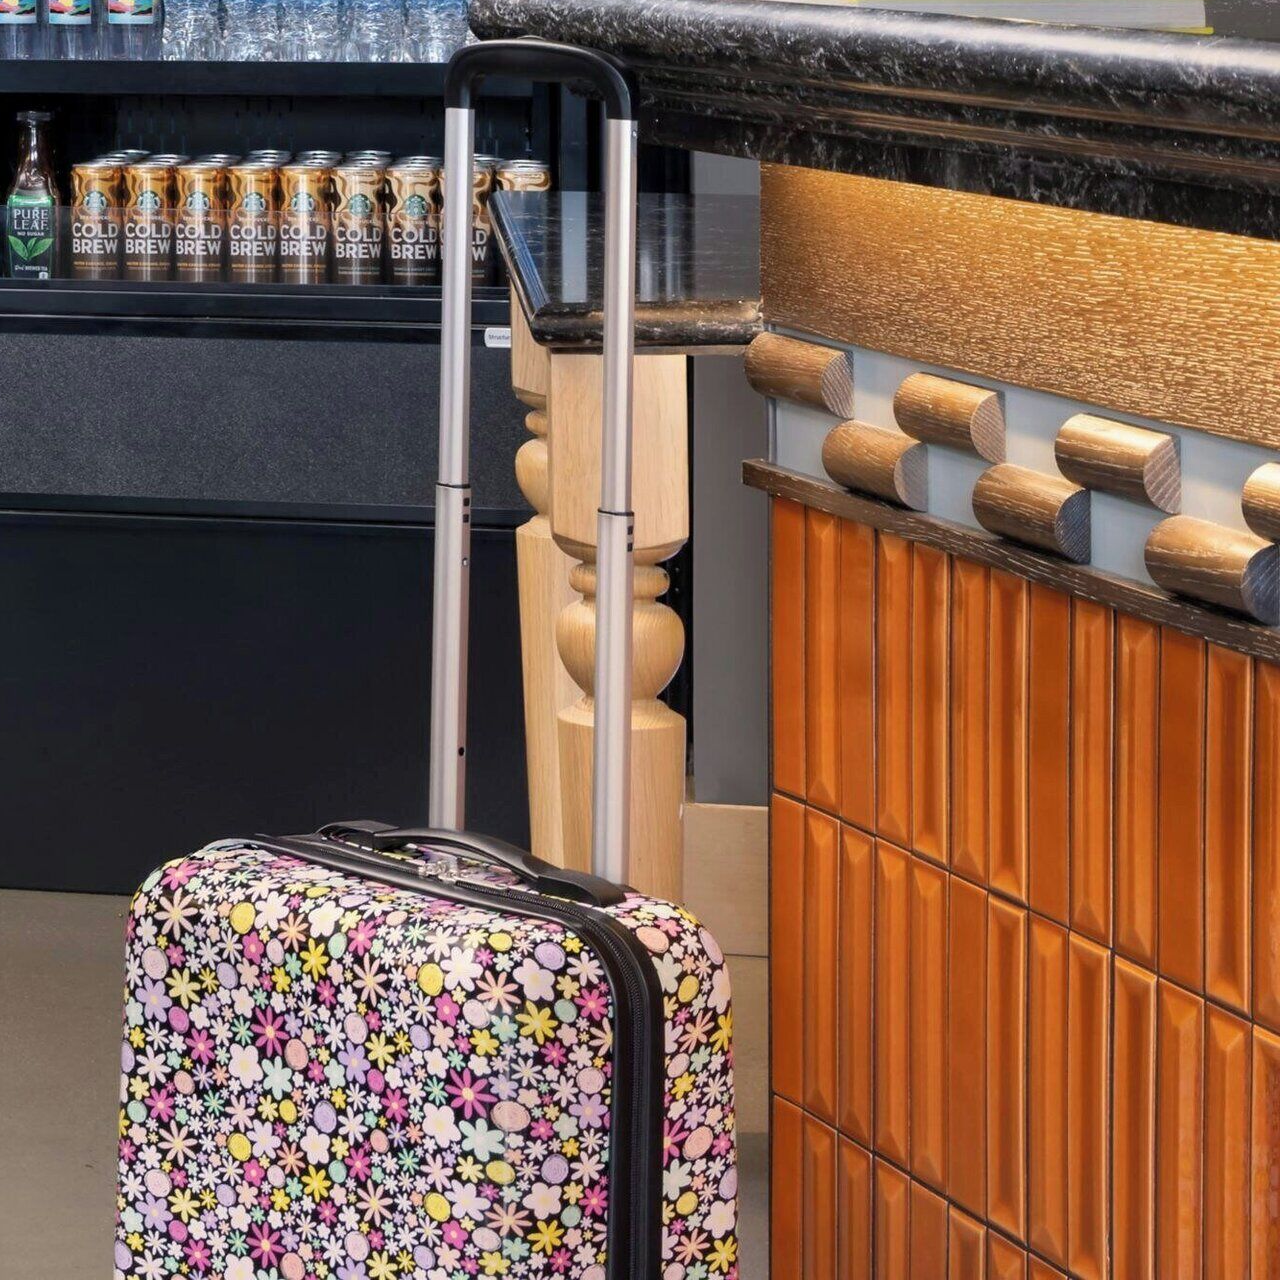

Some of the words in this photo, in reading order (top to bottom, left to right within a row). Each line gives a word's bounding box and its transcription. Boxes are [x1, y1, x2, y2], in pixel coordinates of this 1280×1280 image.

[72, 223, 119, 238] COLD
[125, 223, 171, 239] COLD
[175, 223, 222, 239] COLD
[72, 238, 118, 254] BREW
[125, 239, 171, 255] BREW
[175, 239, 222, 255] BREW
